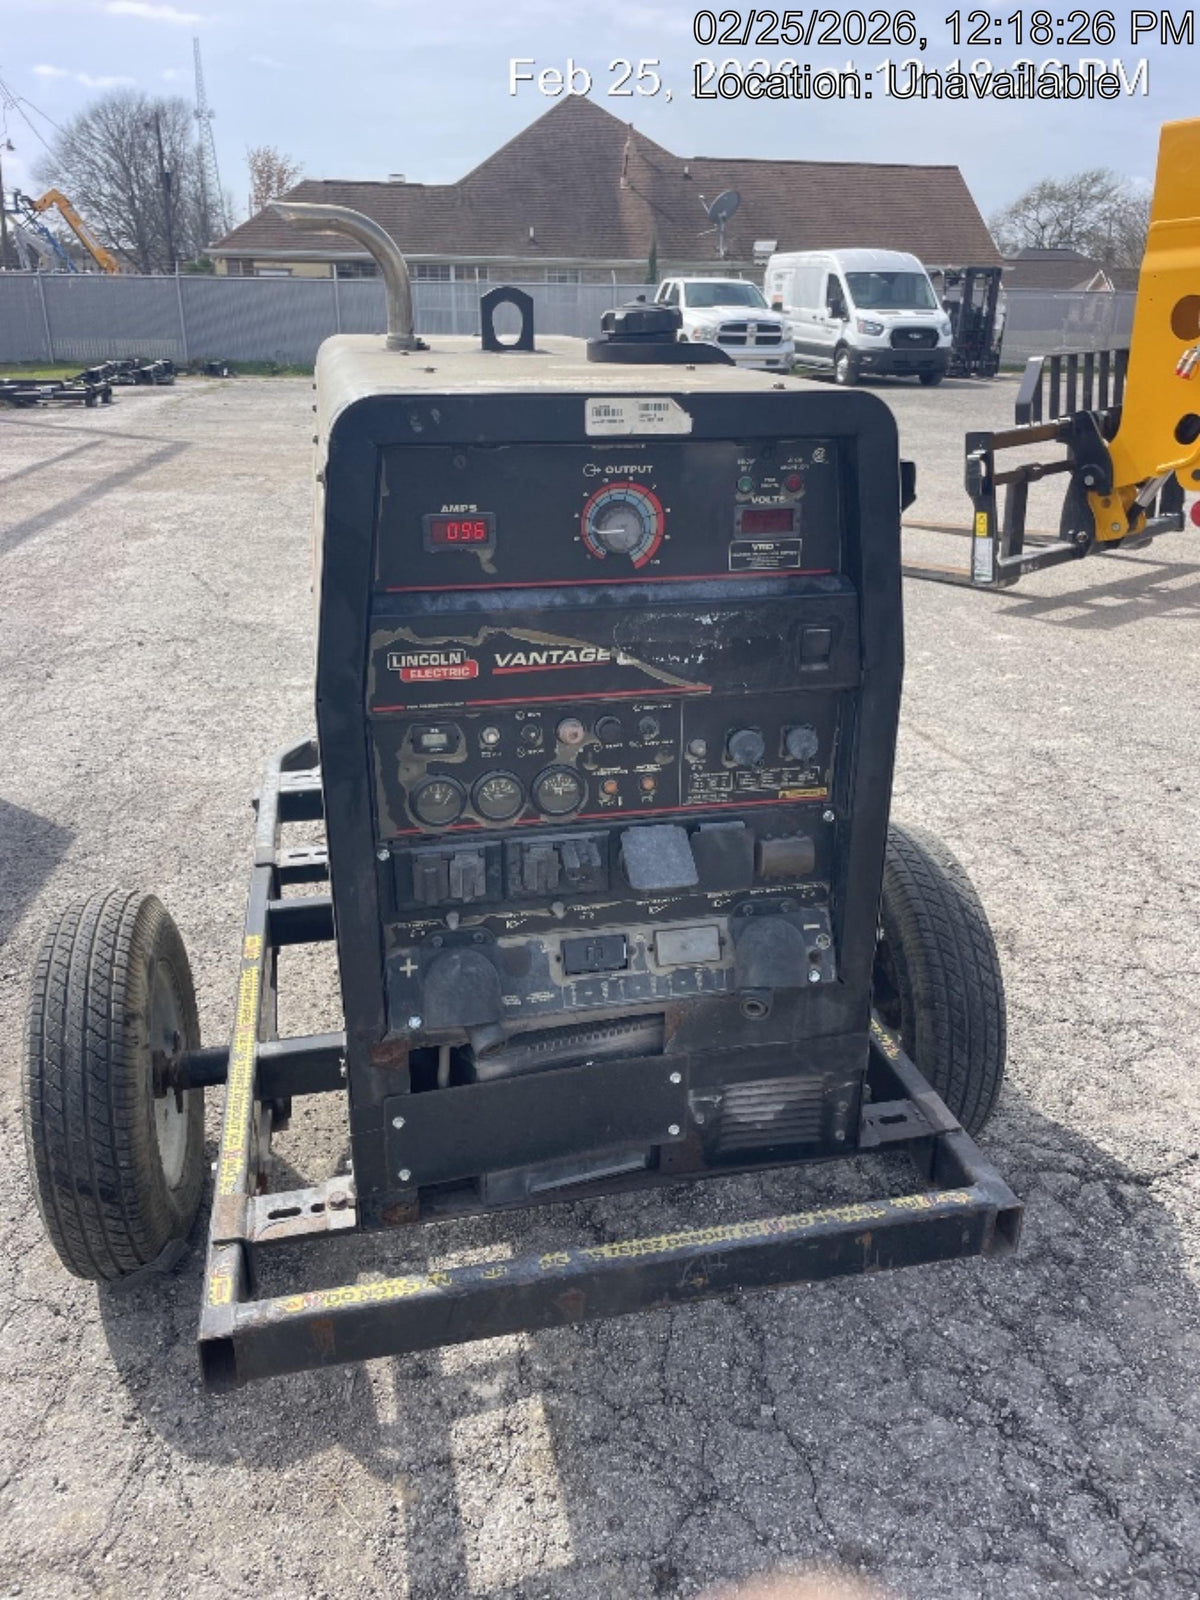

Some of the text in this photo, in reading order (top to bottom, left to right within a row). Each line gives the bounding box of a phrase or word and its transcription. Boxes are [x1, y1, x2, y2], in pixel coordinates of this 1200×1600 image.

[605, 465, 653, 473] OUTPUT
[440, 504, 478, 513] AMPS
[446, 521, 485, 541] 096
[392, 652, 461, 667] LINCOLN
[494, 648, 611, 667] VANTAGE
[410, 666, 470, 679] ELECTRIC
[326, 1292, 355, 1304] DO
